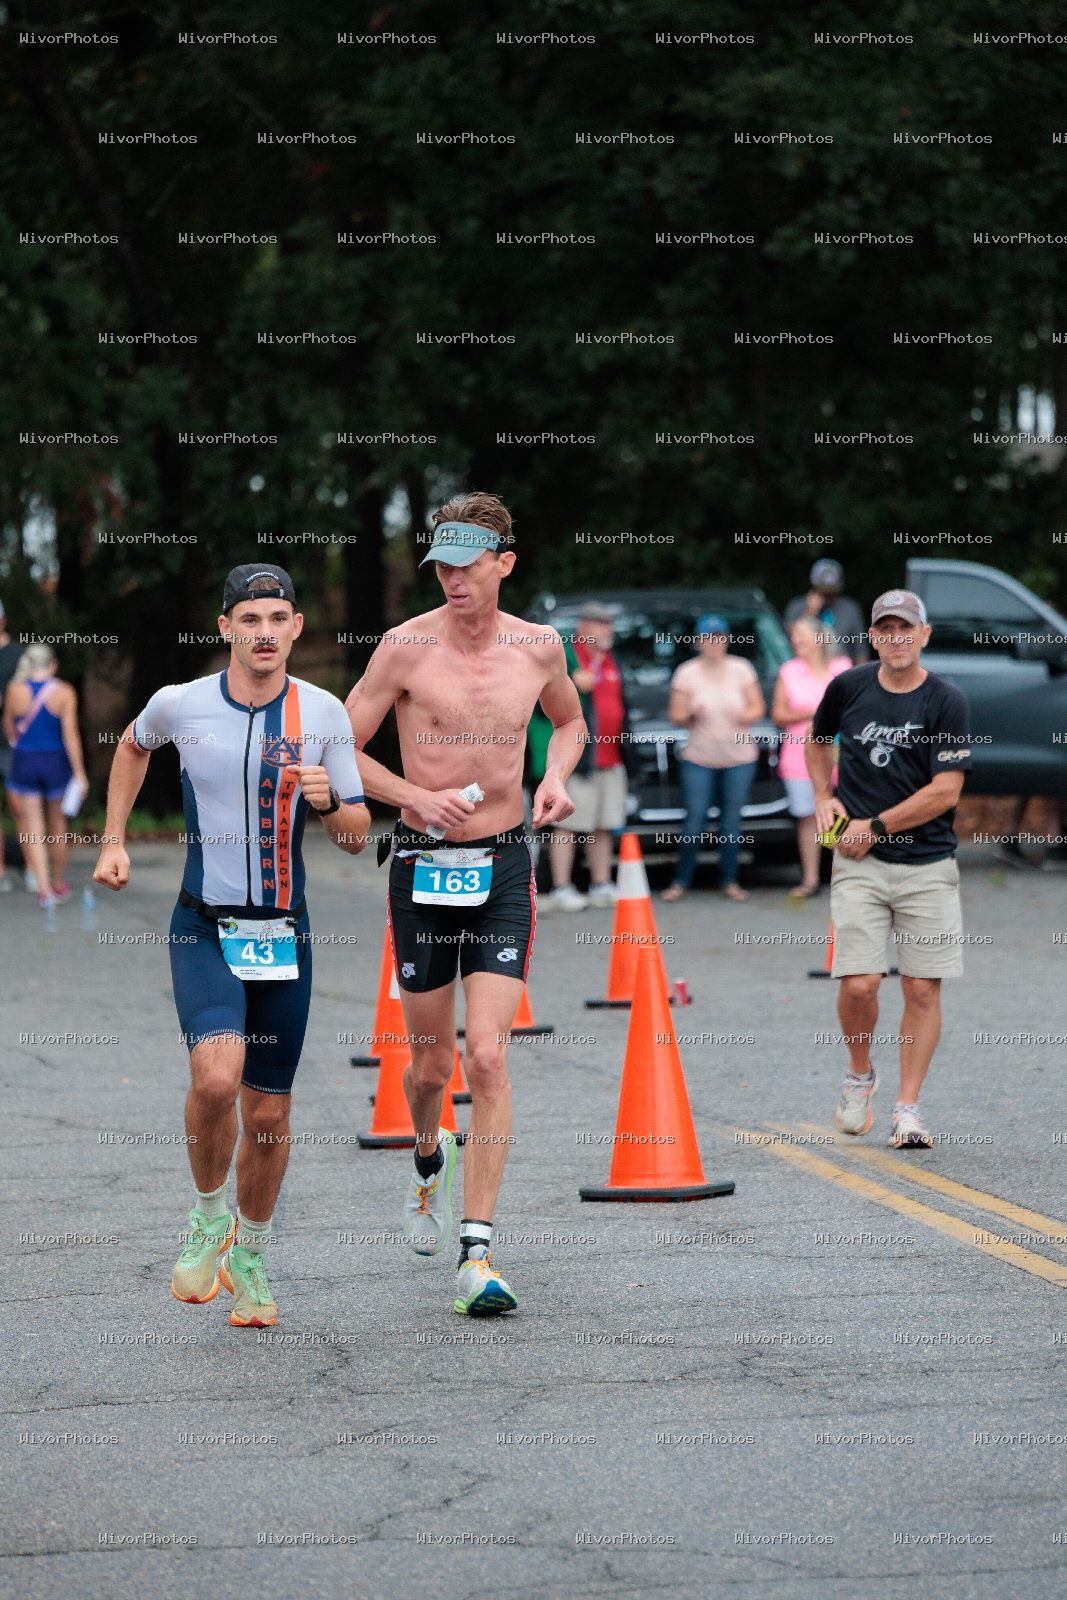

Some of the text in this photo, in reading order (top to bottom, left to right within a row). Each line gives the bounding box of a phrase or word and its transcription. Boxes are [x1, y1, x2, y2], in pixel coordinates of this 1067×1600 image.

[937, 748, 971, 762] GMP
[260, 778, 275, 890] AUBURN
[279, 780, 294, 889] TRIATHLON
[428, 869, 481, 893] 163
[241, 941, 275, 965] 43
